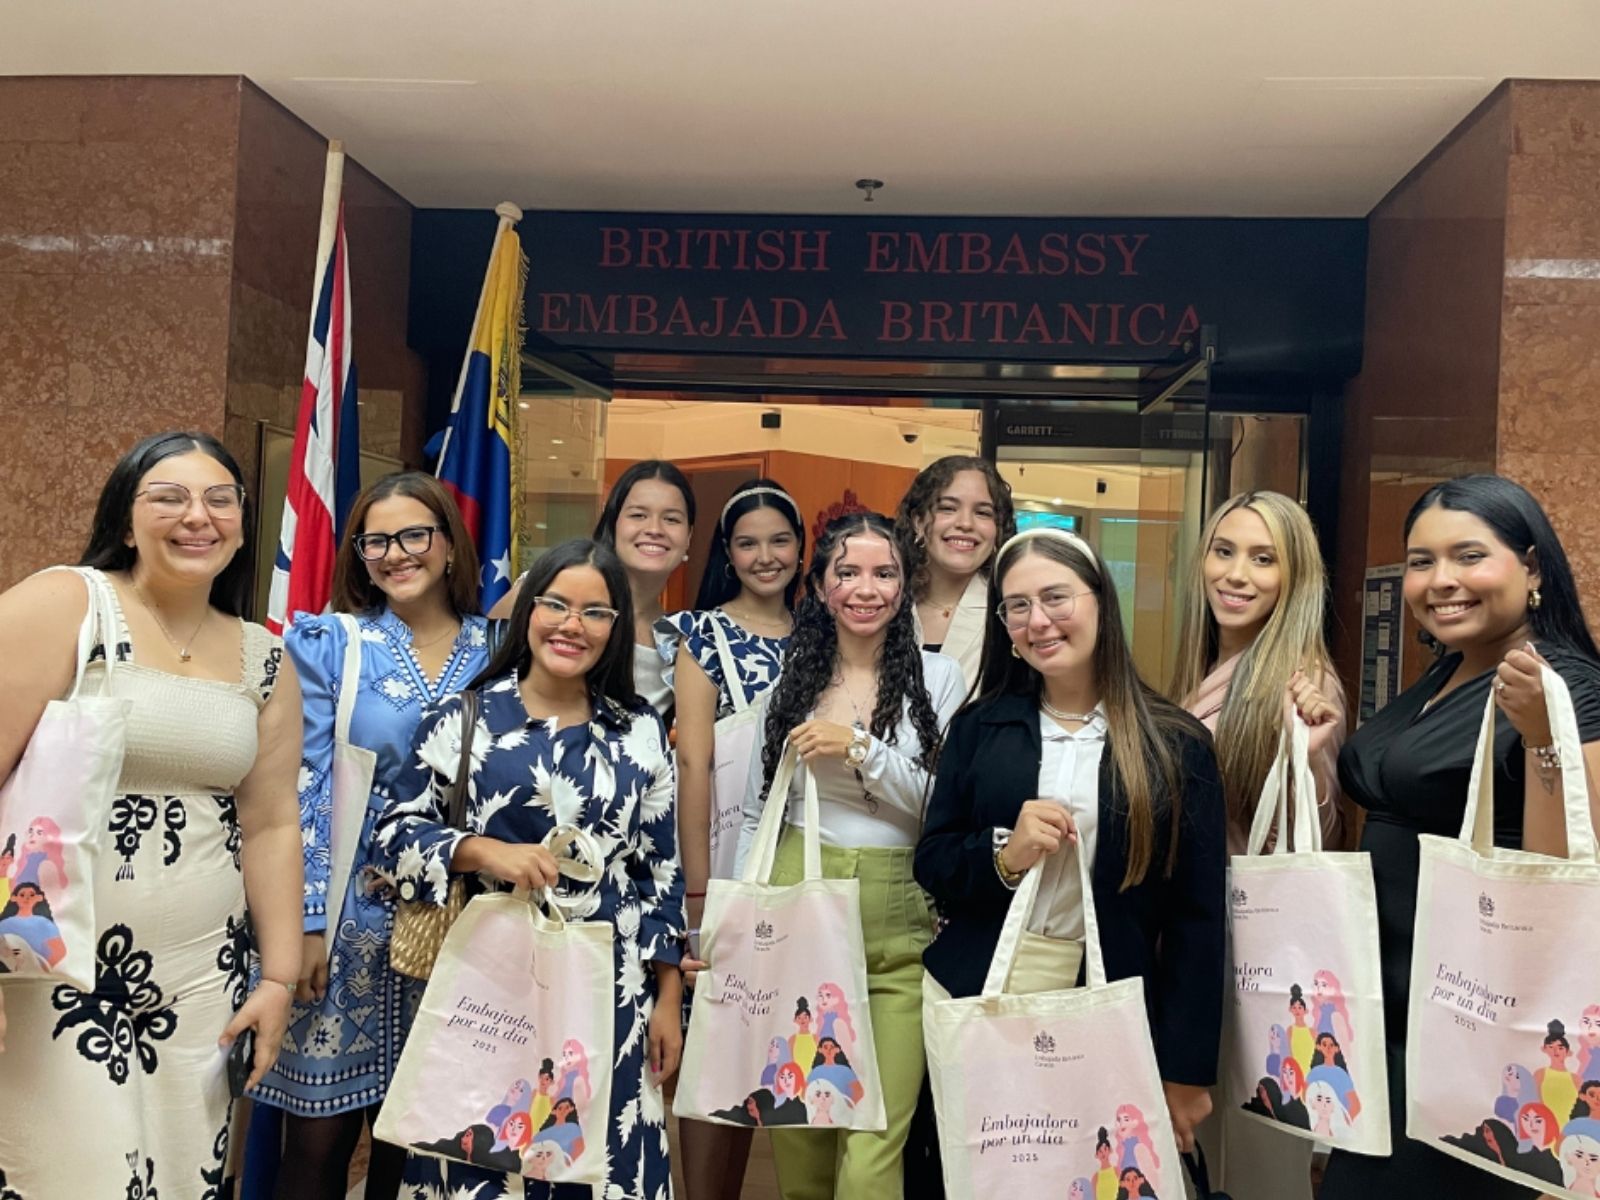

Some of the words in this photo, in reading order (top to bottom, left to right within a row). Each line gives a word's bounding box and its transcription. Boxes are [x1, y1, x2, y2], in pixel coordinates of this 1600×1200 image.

[598, 227, 830, 272] BRITISH
[866, 231, 1150, 277] EMBASSY
[538, 293, 848, 341] EMBAJADA
[877, 301, 1201, 346] BRITANICA
[1006, 425, 1054, 436] GARRETT
[1431, 985, 1455, 1001] por
[1456, 994, 1474, 1011] un
[447, 1014, 477, 1028] por
[479, 1023, 499, 1037] un
[457, 995, 536, 1033] Embajador
[981, 1112, 1079, 1133] Embajadora
[980, 1136, 1007, 1154] por
[1012, 1134, 1031, 1146] un
[1012, 1153, 1038, 1163] 2025
